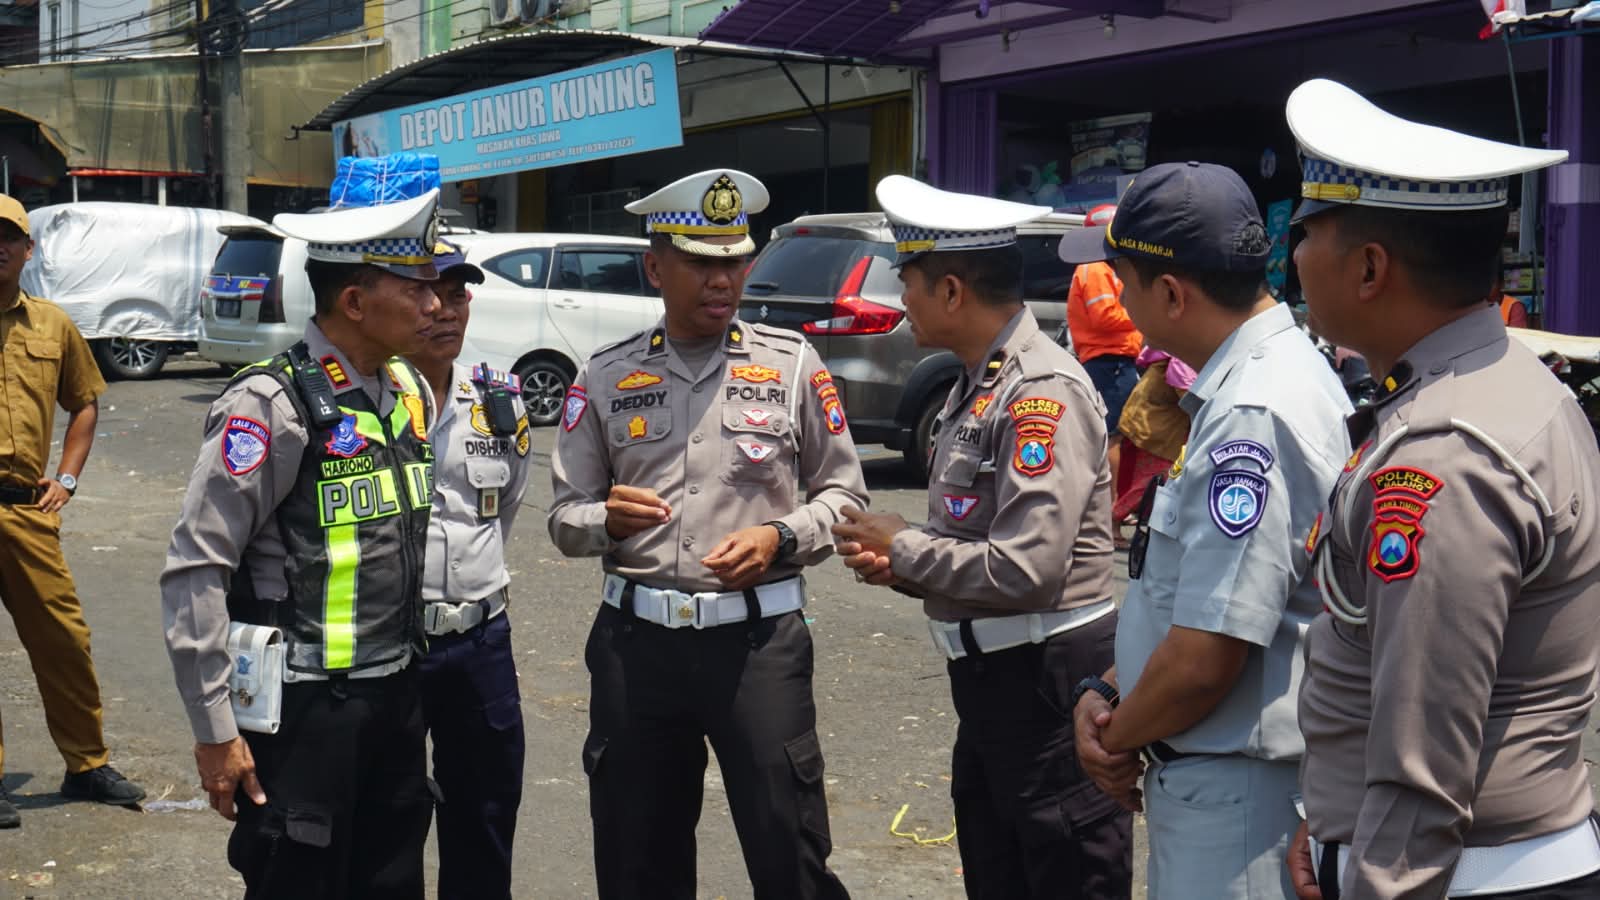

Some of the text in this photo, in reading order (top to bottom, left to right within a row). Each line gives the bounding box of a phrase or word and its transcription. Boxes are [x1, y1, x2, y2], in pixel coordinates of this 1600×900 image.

[400, 61, 656, 150] DEPOT JANUR KUNING
[515, 134, 537, 149] KHAS
[1119, 237, 1174, 258] JASA RAHARJA
[611, 391, 668, 413] DEDDY
[726, 386, 786, 404] POLRI
[1014, 399, 1060, 410] POLRES
[1016, 406, 1058, 416] MALANG
[232, 419, 250, 428] LALU
[954, 425, 982, 445] POLRI
[465, 440, 509, 456] DISHUB
[1216, 445, 1249, 461] WILAYAH
[324, 458, 372, 475] HARIONO
[1216, 477, 1233, 488] JASA
[1376, 471, 1435, 490] POLRES
[1384, 480, 1424, 492] MALANG
